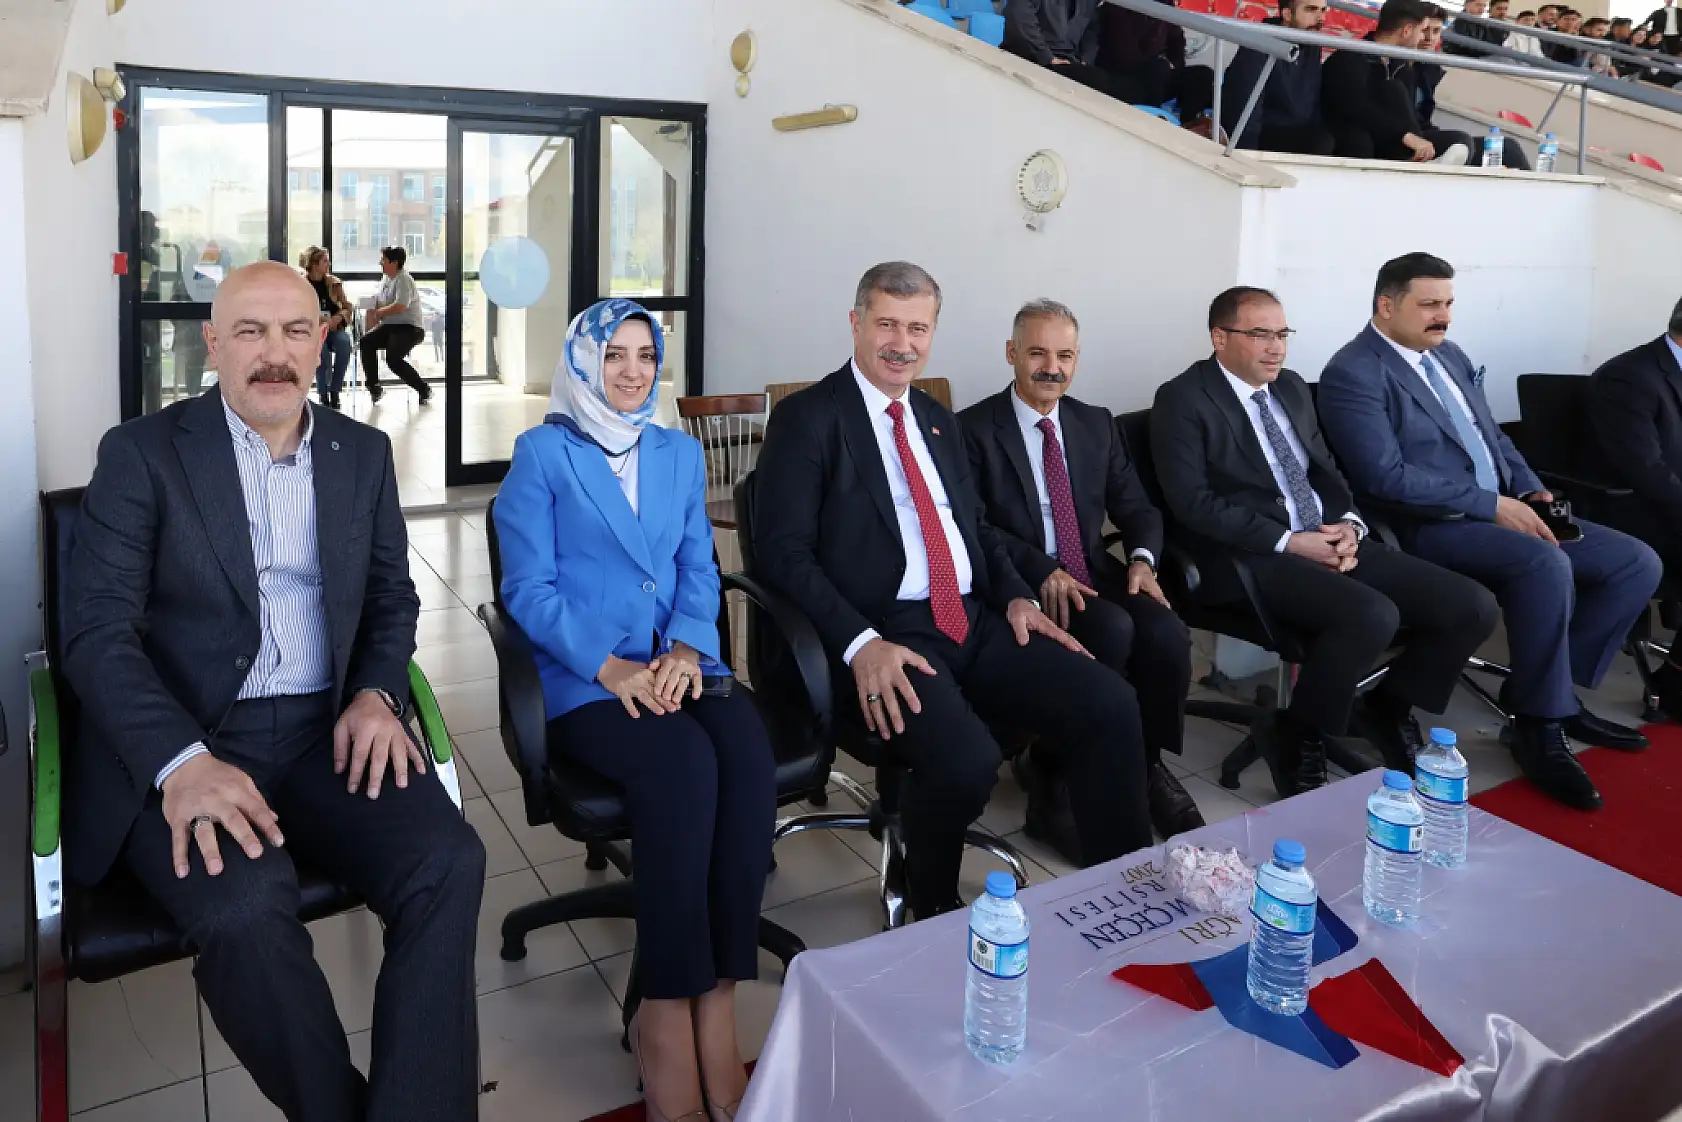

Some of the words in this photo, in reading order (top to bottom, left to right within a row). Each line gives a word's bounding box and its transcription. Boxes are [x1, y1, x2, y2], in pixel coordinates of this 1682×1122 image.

[1120, 860, 1162, 884] 2007
[1053, 879, 1166, 928] RSITESI
[1080, 903, 1174, 950] ÇEÇEN
